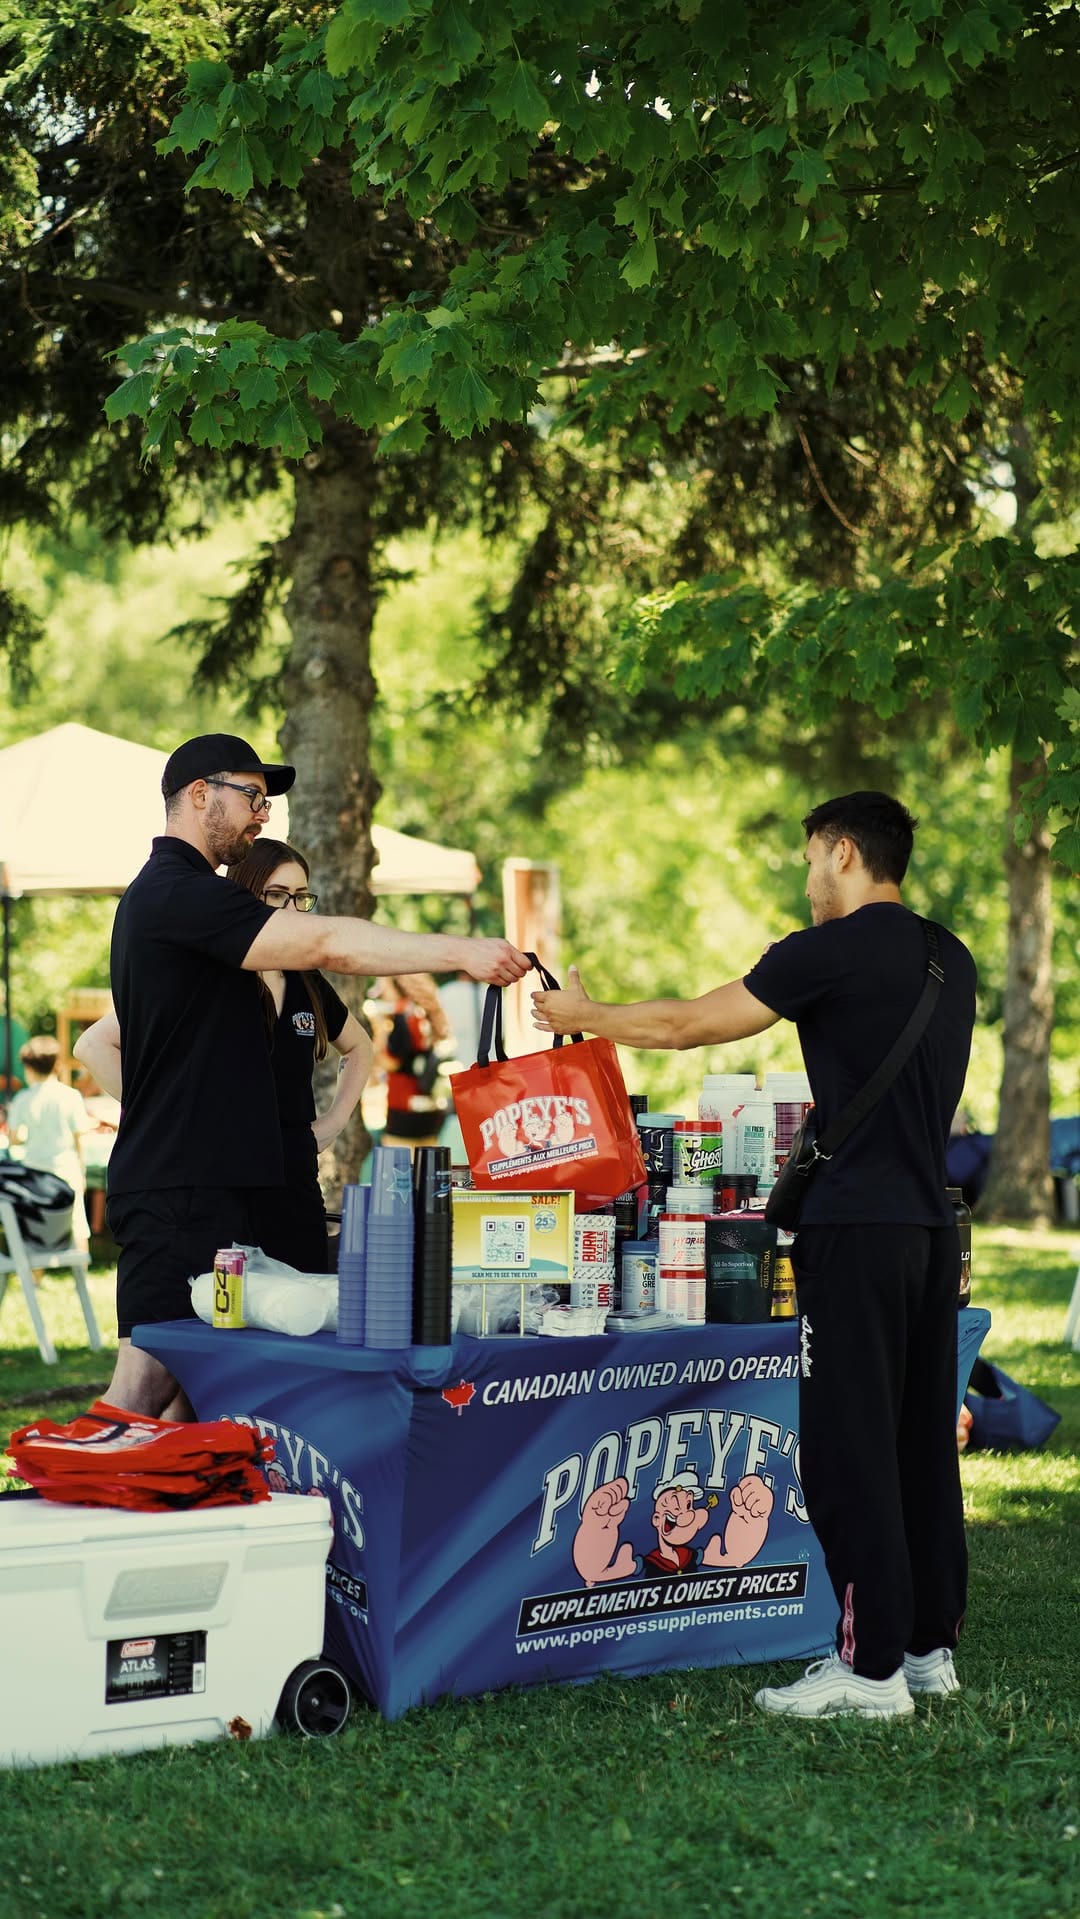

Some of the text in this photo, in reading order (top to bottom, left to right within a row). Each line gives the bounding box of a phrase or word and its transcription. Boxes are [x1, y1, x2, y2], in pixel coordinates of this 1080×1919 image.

[480, 1095, 592, 1152] POPEYE'S
[533, 1152, 546, 1164] AUX
[546, 1145, 578, 1160] MEILLEURS
[578, 1140, 593, 1152] PRIX
[531, 1195, 561, 1205] SALE!
[582, 1231, 597, 1263] BURN
[215, 1266, 230, 1314] C4
[598, 1284, 610, 1307] URN
[482, 1355, 799, 1406] CANADIAN OWNED AND OPERAT
[527, 1571, 799, 1627] SUPPLEMENTS LOWEST PRICES
[515, 1601, 804, 1655] www.popeyessupplements.com
[120, 1657, 156, 1674] ATLAS
